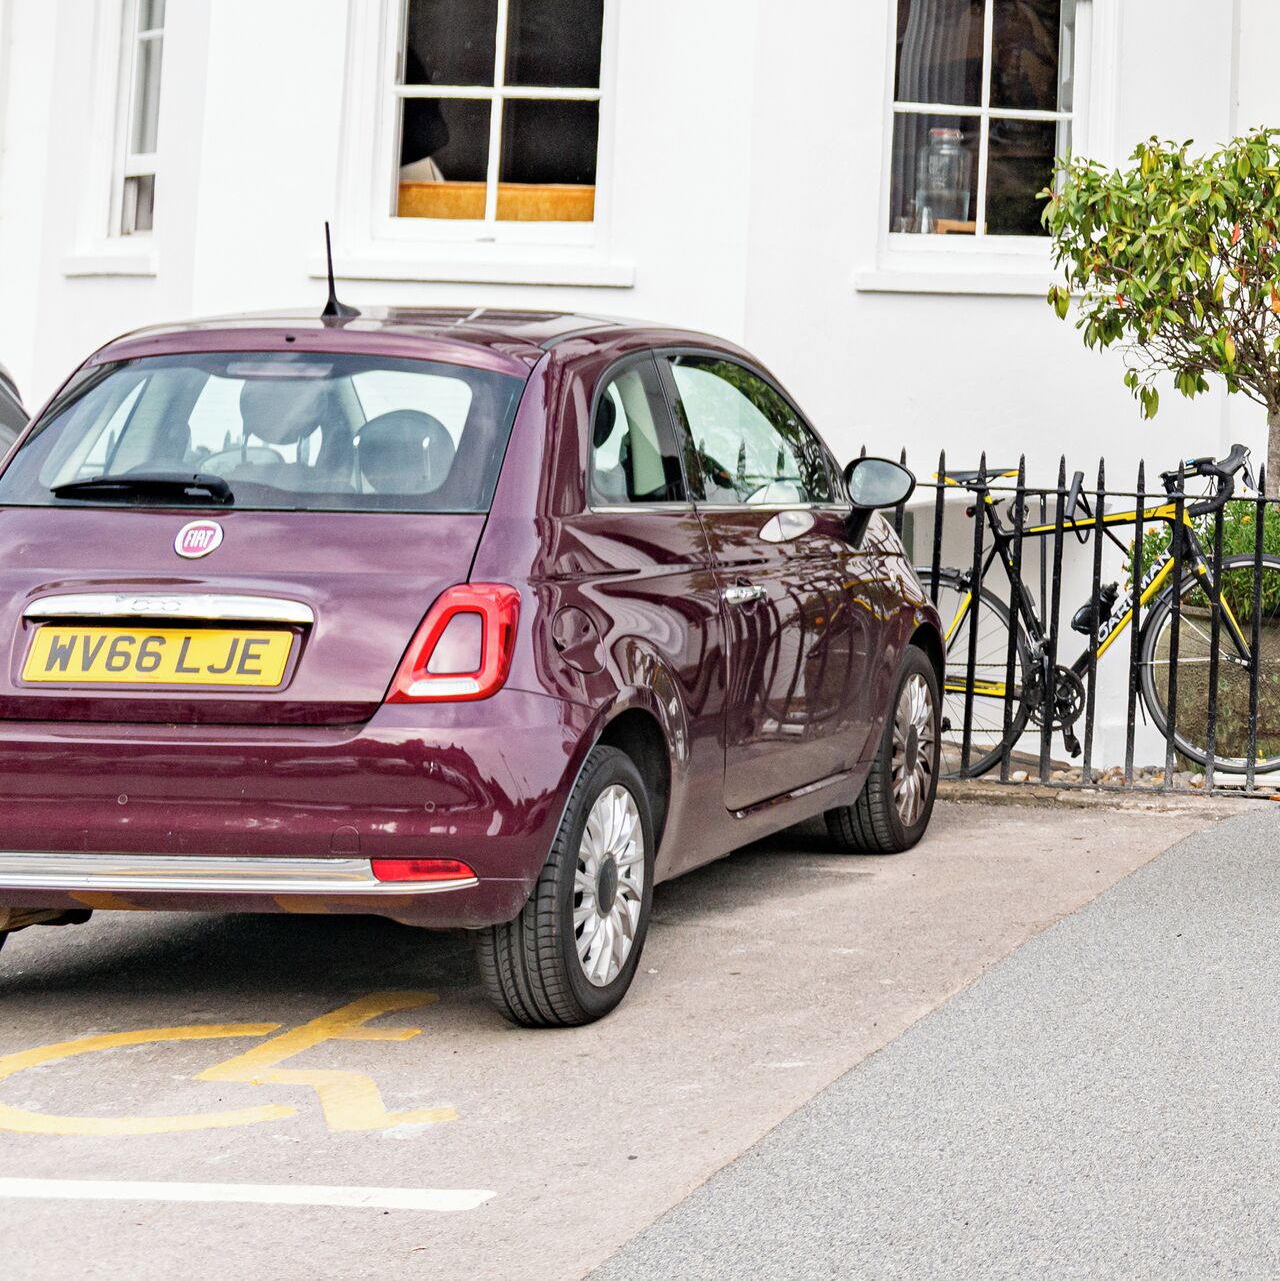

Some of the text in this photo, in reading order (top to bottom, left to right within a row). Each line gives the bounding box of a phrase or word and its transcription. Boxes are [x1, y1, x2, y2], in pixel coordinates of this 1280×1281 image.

[183, 530, 215, 548] FIAT
[1087, 549, 1172, 652] OARMAN
[44, 634, 271, 676] WV66 LJE
